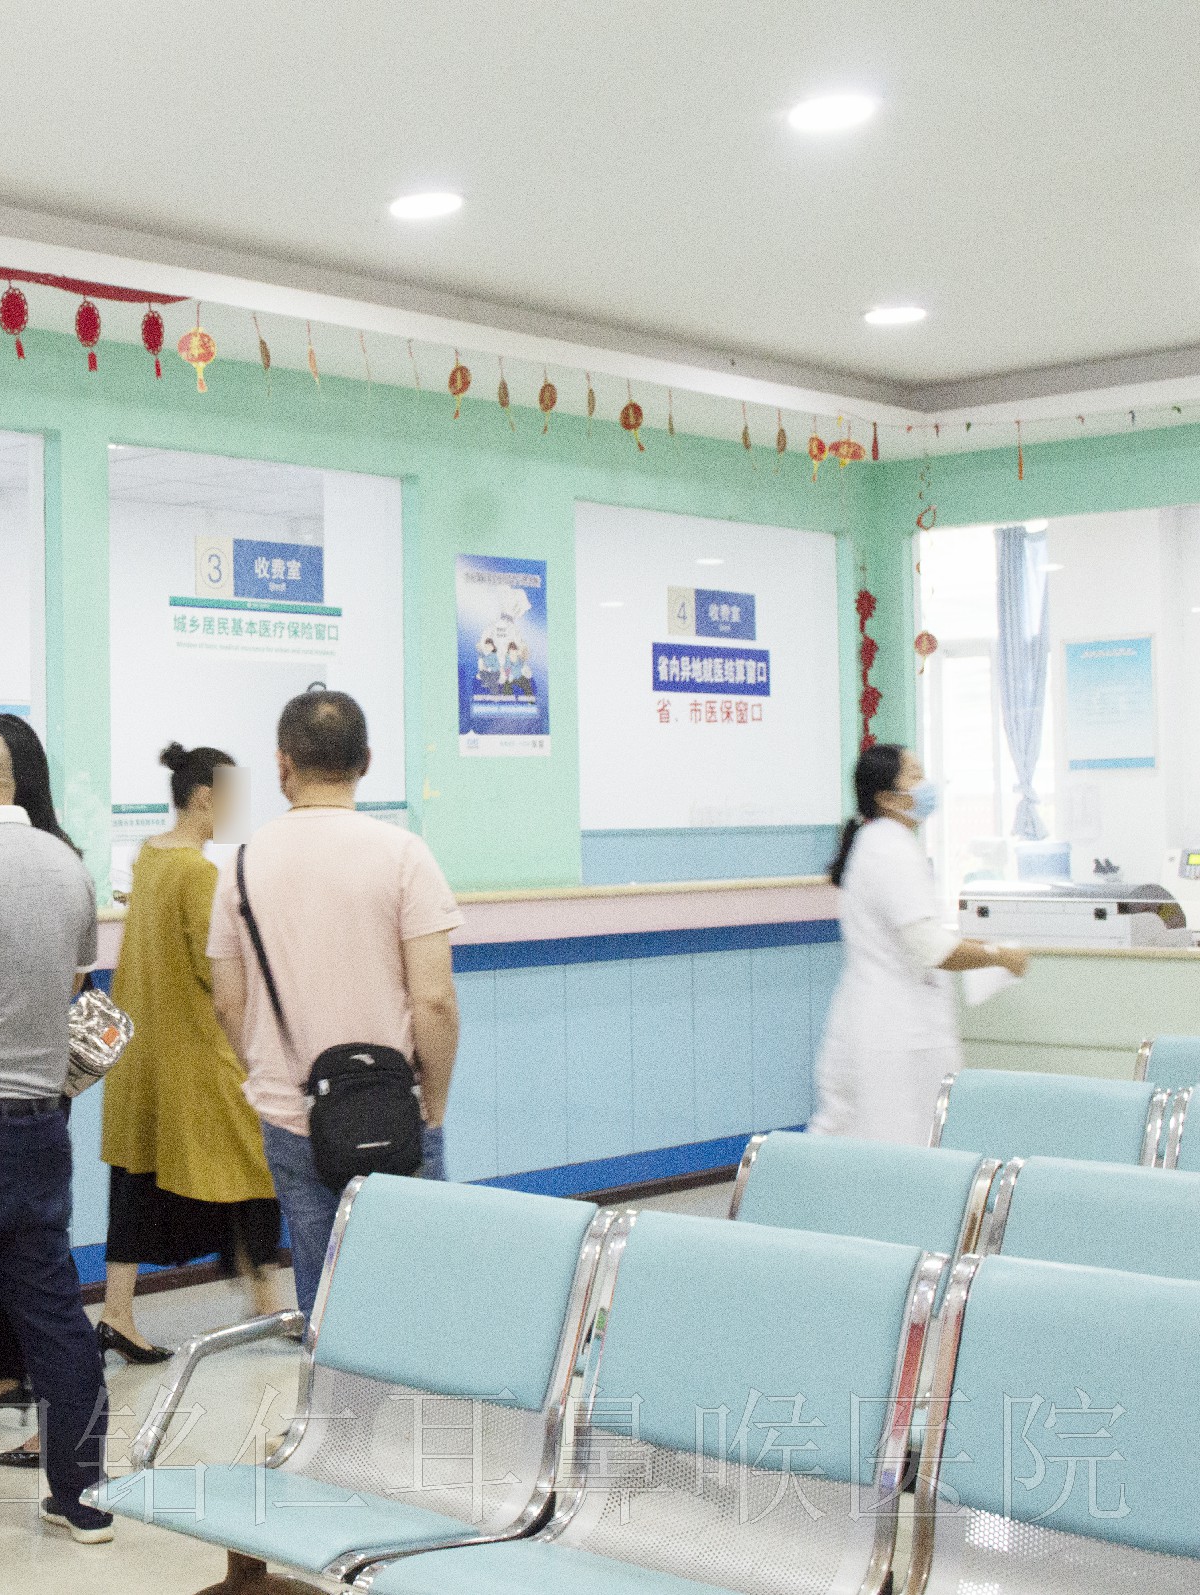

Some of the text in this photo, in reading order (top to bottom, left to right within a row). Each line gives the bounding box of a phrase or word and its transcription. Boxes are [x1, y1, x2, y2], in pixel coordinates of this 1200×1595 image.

[207, 553, 223, 584] 3
[254, 556, 301, 581] 收费室
[173, 613, 340, 641] 城乡居民基本医疗保险窗口
[708, 603, 741, 623] 收费室
[658, 655, 767, 685] 省内异地就医结算窗口
